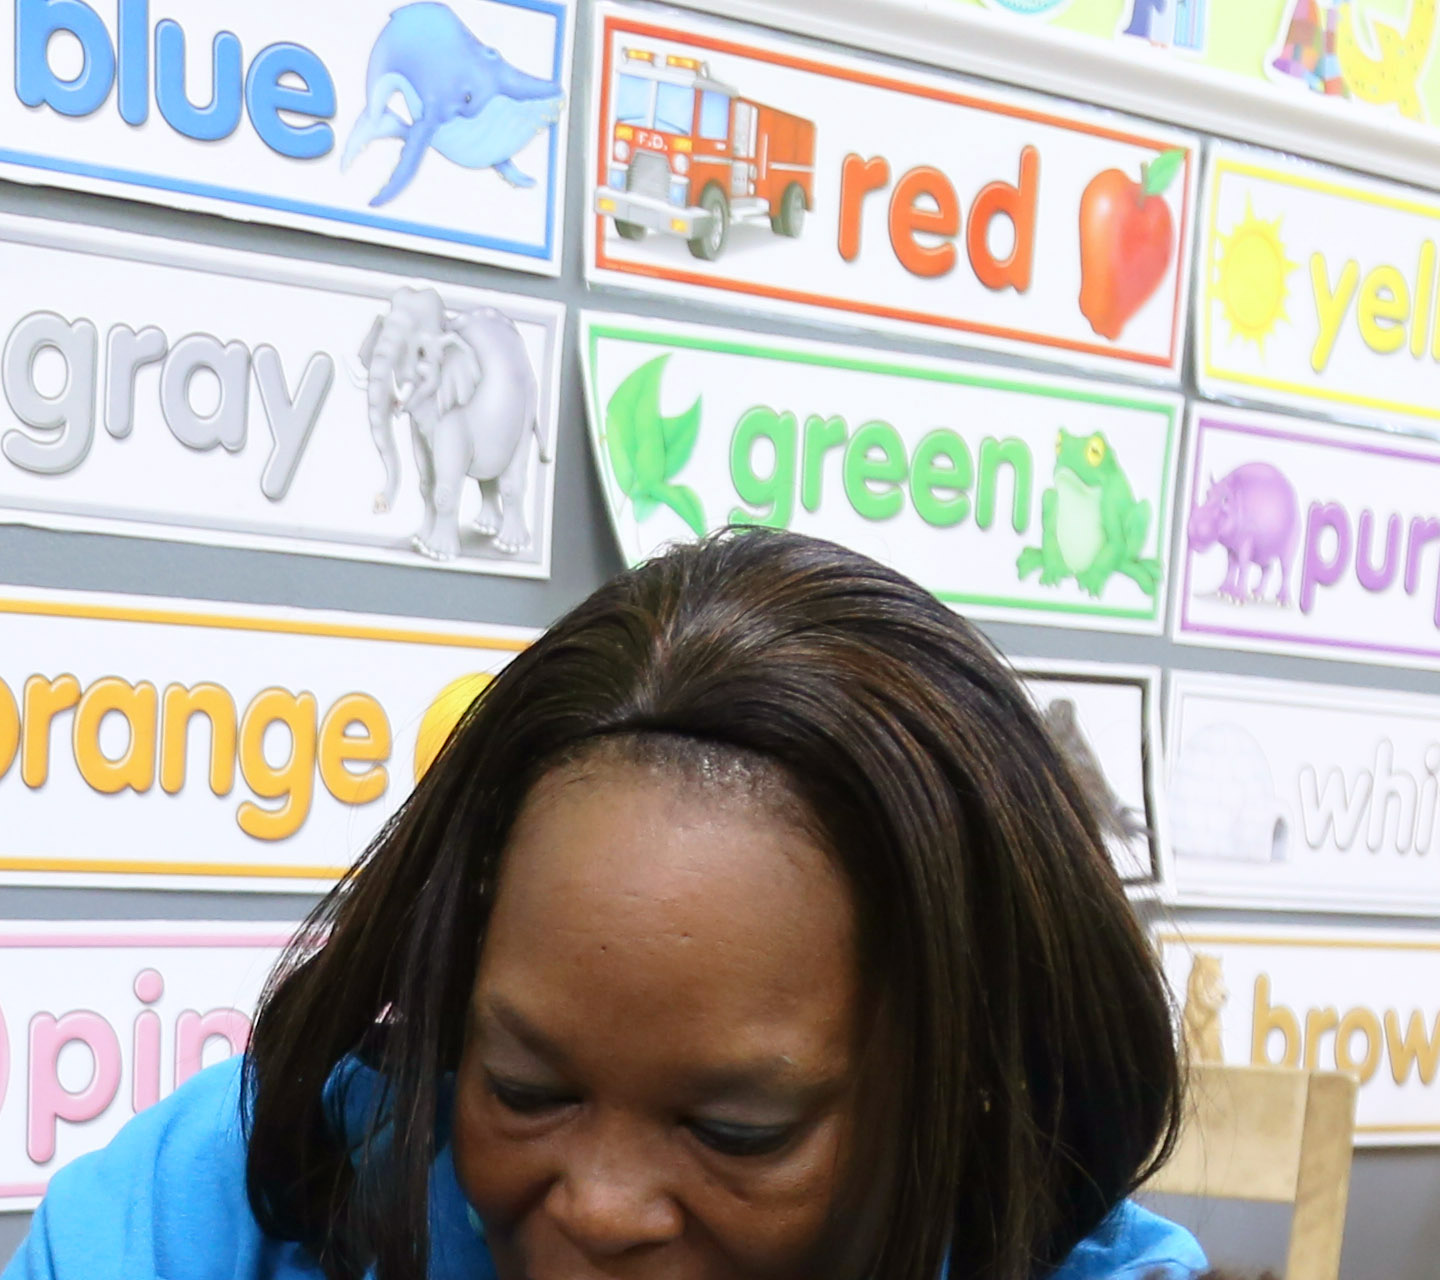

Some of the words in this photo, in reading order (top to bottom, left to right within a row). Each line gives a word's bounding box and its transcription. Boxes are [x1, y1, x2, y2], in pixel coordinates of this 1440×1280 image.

[15, 0, 337, 159] blue
[638, 132, 668, 150] F.D.
[837, 144, 1038, 292] red
[2, 310, 335, 501] gray
[728, 405, 1031, 532] green
[27, 967, 251, 1164] pin
